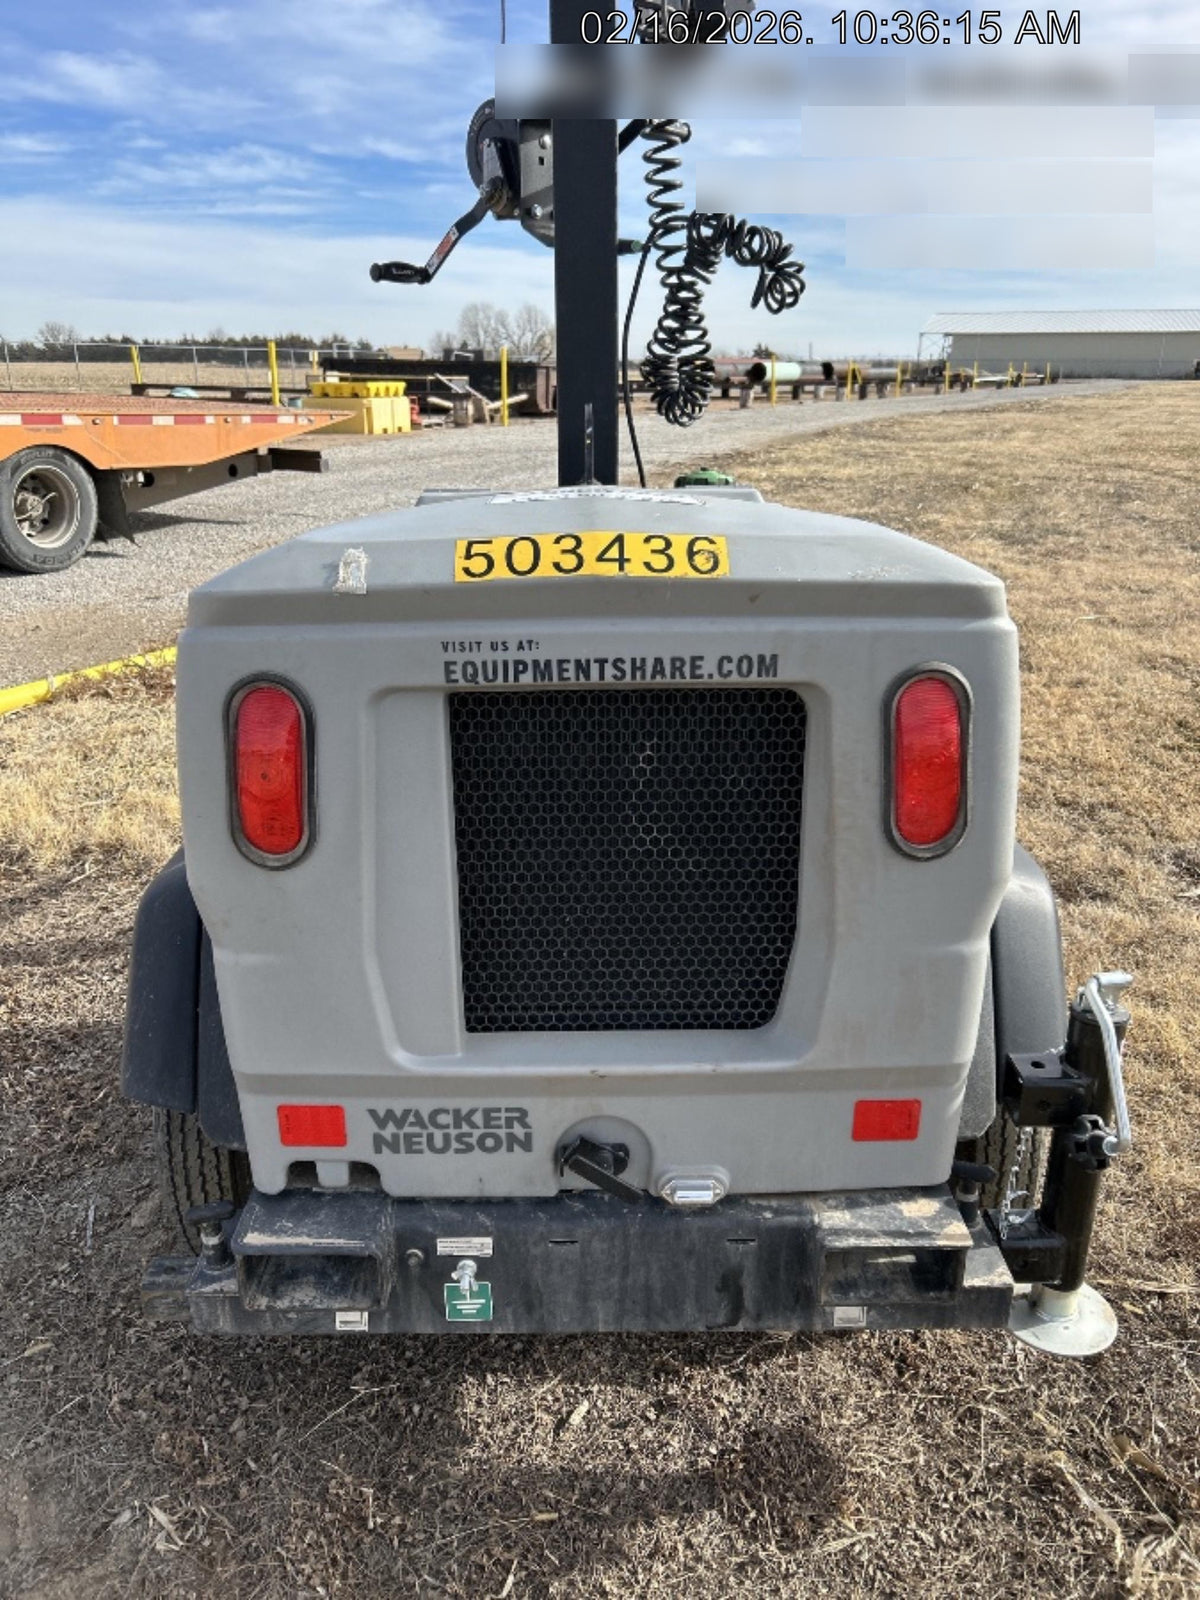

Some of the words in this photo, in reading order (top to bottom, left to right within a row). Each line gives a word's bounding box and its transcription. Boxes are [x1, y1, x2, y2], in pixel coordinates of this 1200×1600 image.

[461, 533, 721, 579] 503436
[441, 641, 482, 653] VISIT
[490, 640, 509, 652] US
[516, 639, 540, 651] AT:
[443, 653, 779, 685] EQUIPMENTSHARE.COM
[367, 1107, 532, 1130] WACKER
[373, 1131, 533, 1154] NEUSON
